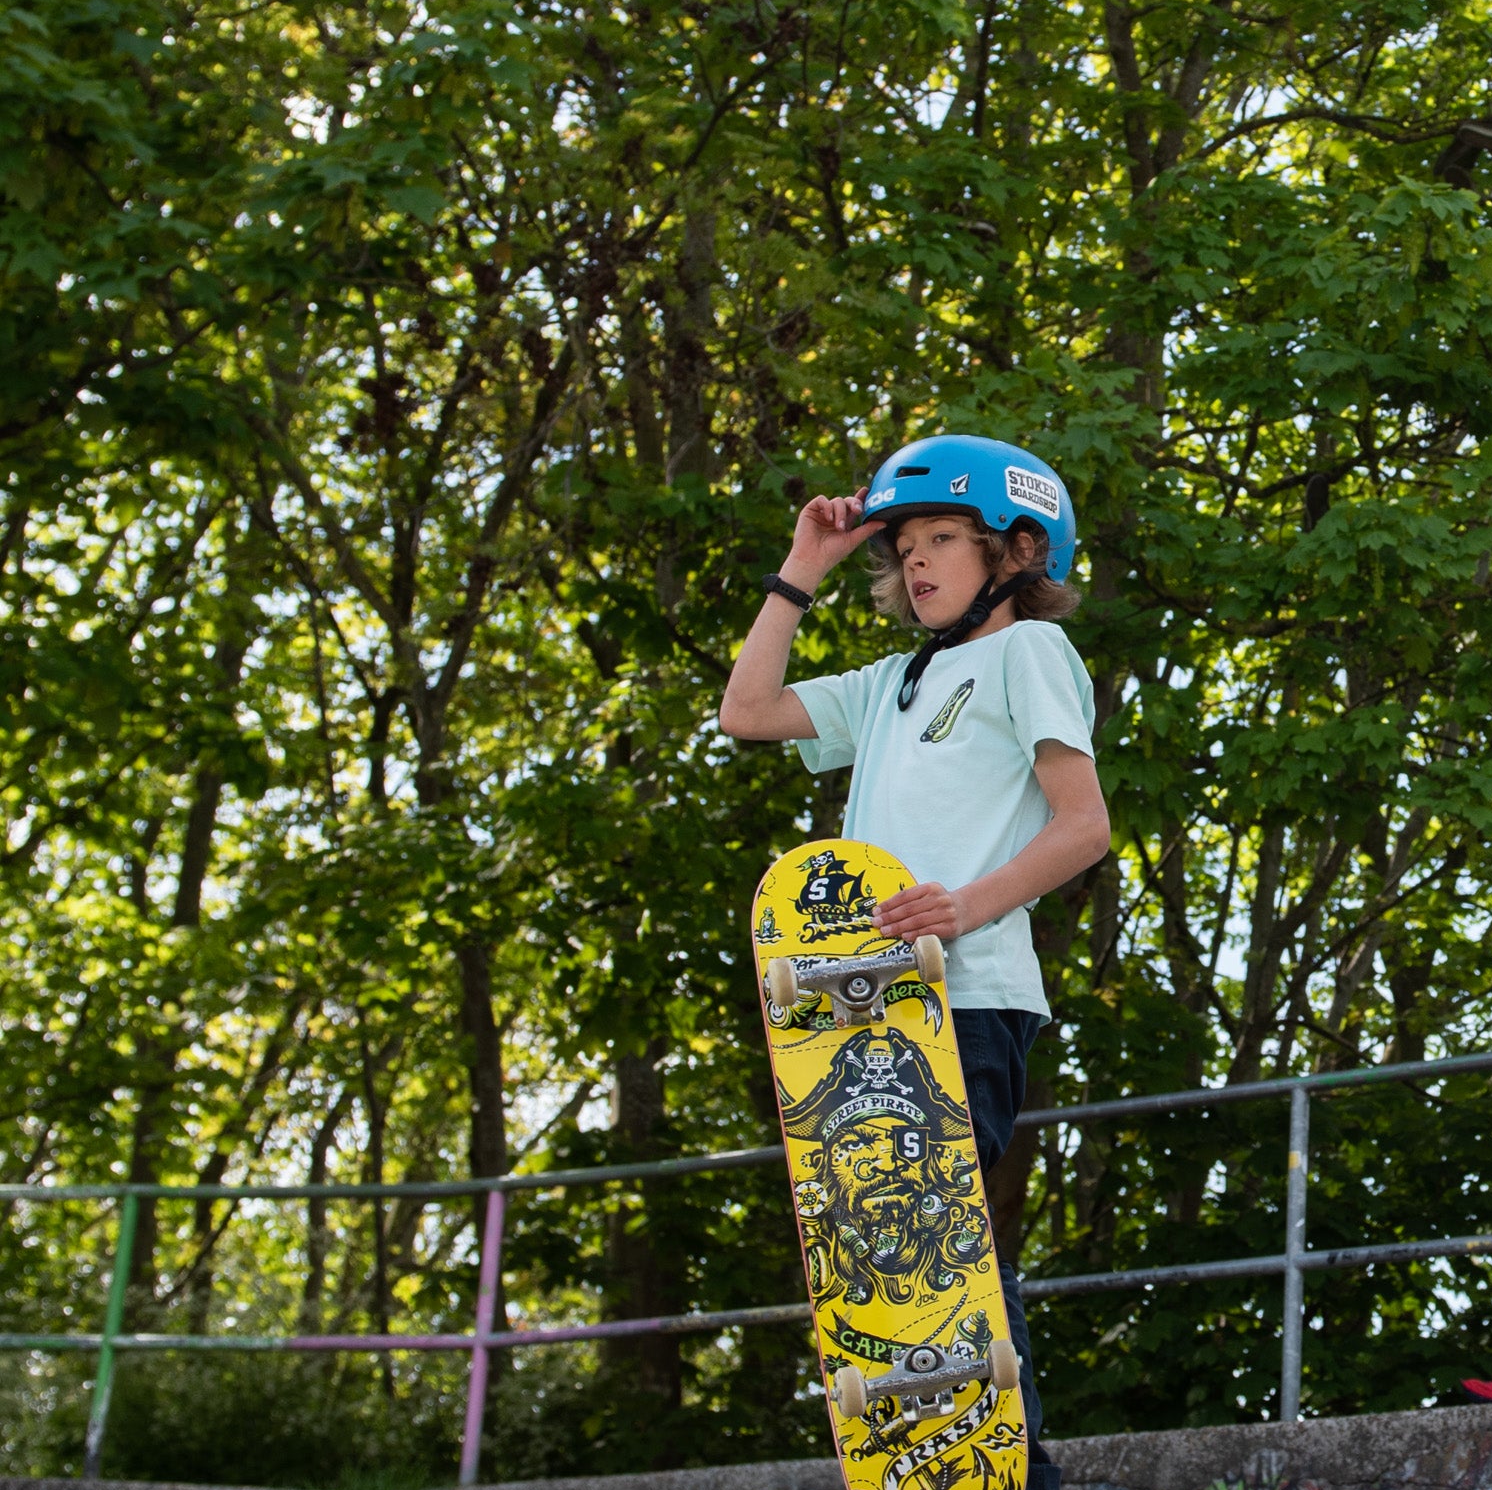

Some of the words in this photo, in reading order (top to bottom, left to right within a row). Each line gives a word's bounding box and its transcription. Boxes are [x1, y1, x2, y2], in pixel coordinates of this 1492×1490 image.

[1007, 470, 1057, 501] STOKED
[1009, 485, 1058, 514] BOARDSHOP
[808, 877, 830, 901] S
[825, 1099, 868, 1134] STREET
[871, 1097, 922, 1118] PIRATE
[903, 1132, 920, 1158] S
[887, 1388, 996, 1484] TRASH
